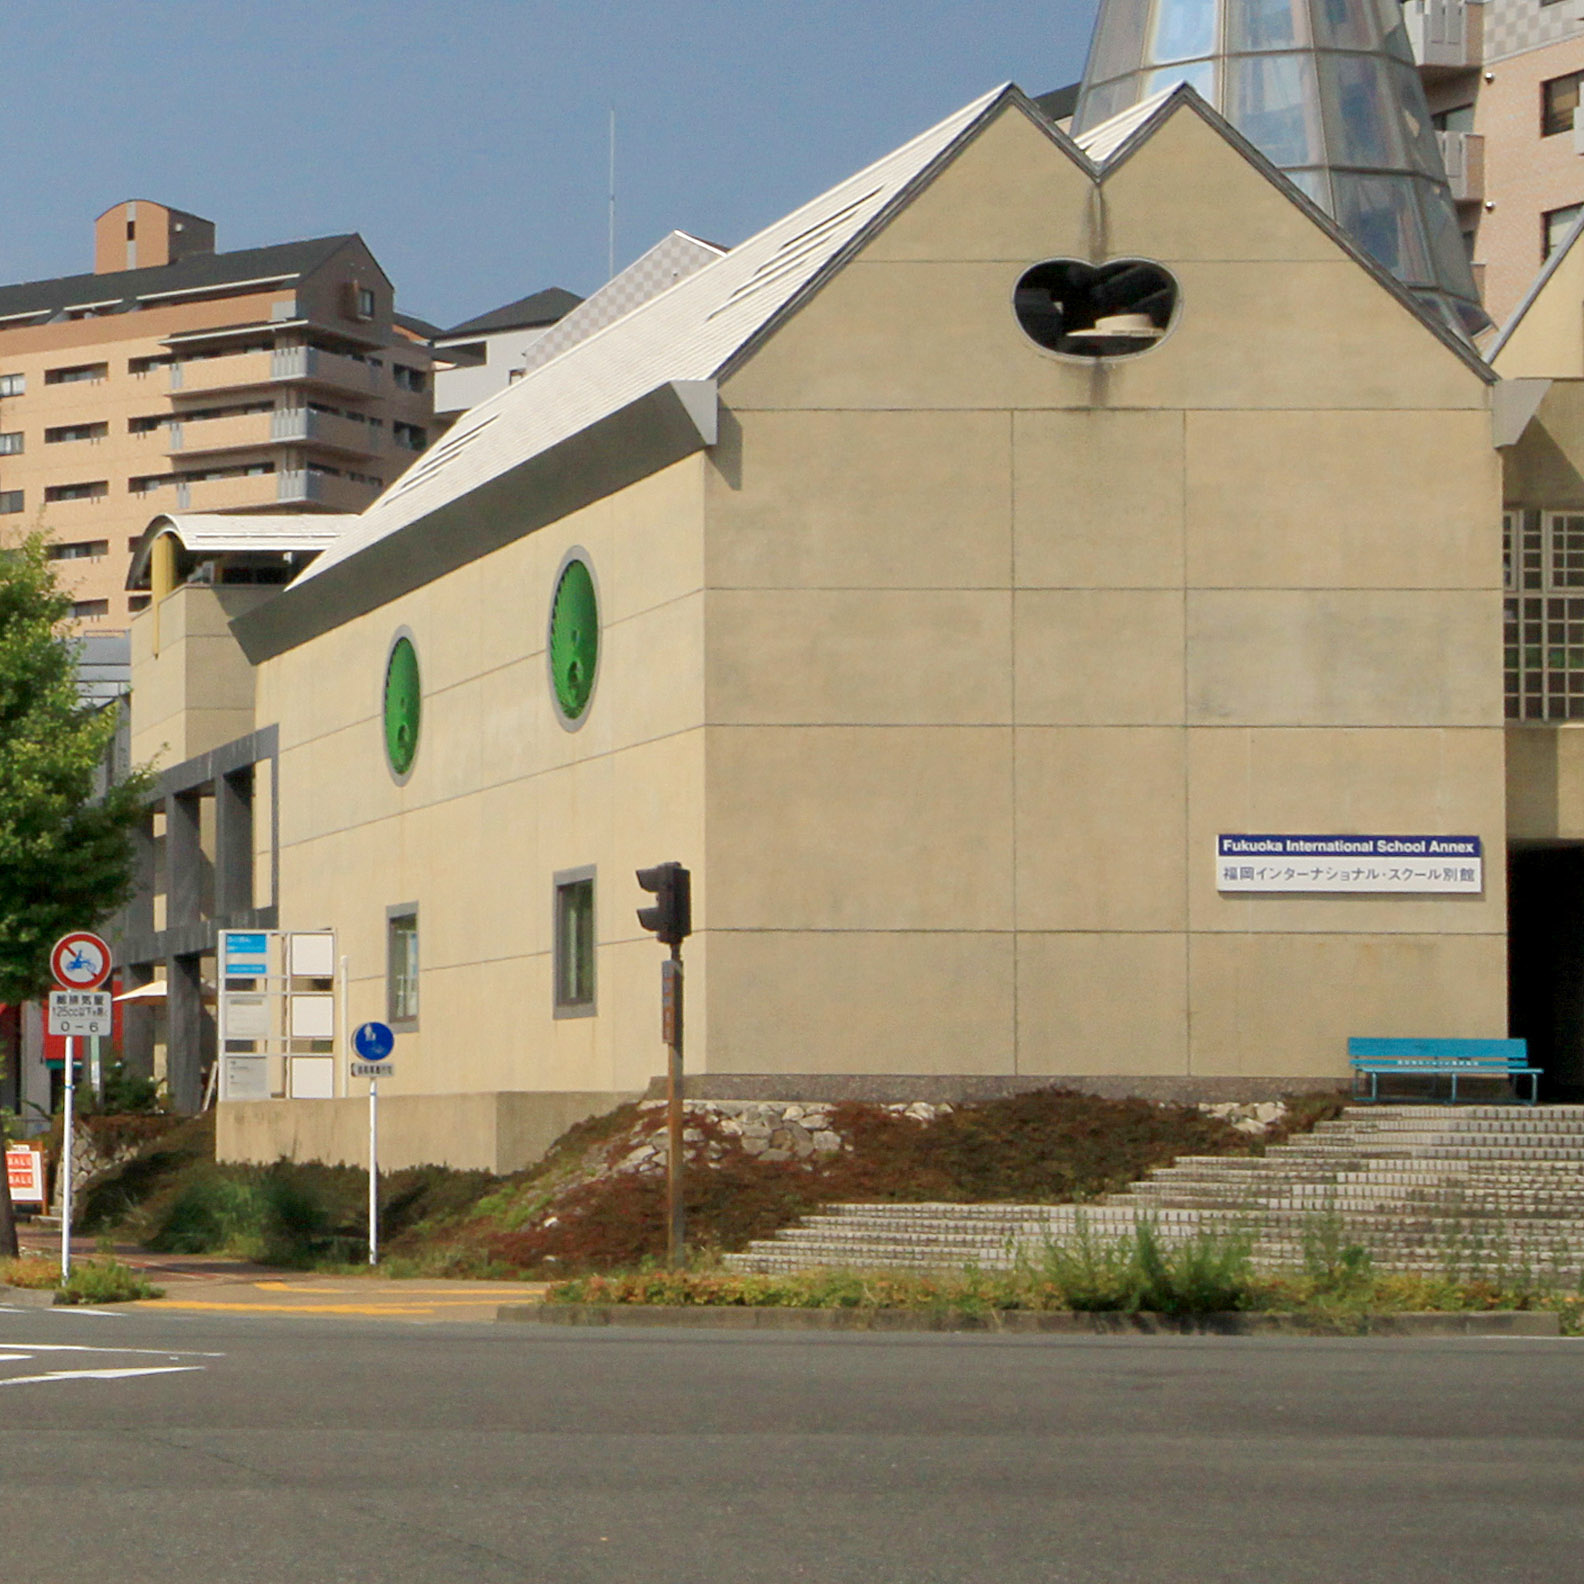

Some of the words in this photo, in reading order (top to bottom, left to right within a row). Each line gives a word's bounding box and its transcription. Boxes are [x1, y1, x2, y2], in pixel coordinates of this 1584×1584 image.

[1223, 839, 1283, 852] Fukuoka
[1286, 839, 1374, 853] International
[1377, 839, 1426, 853] School
[1429, 840, 1475, 853] Annex
